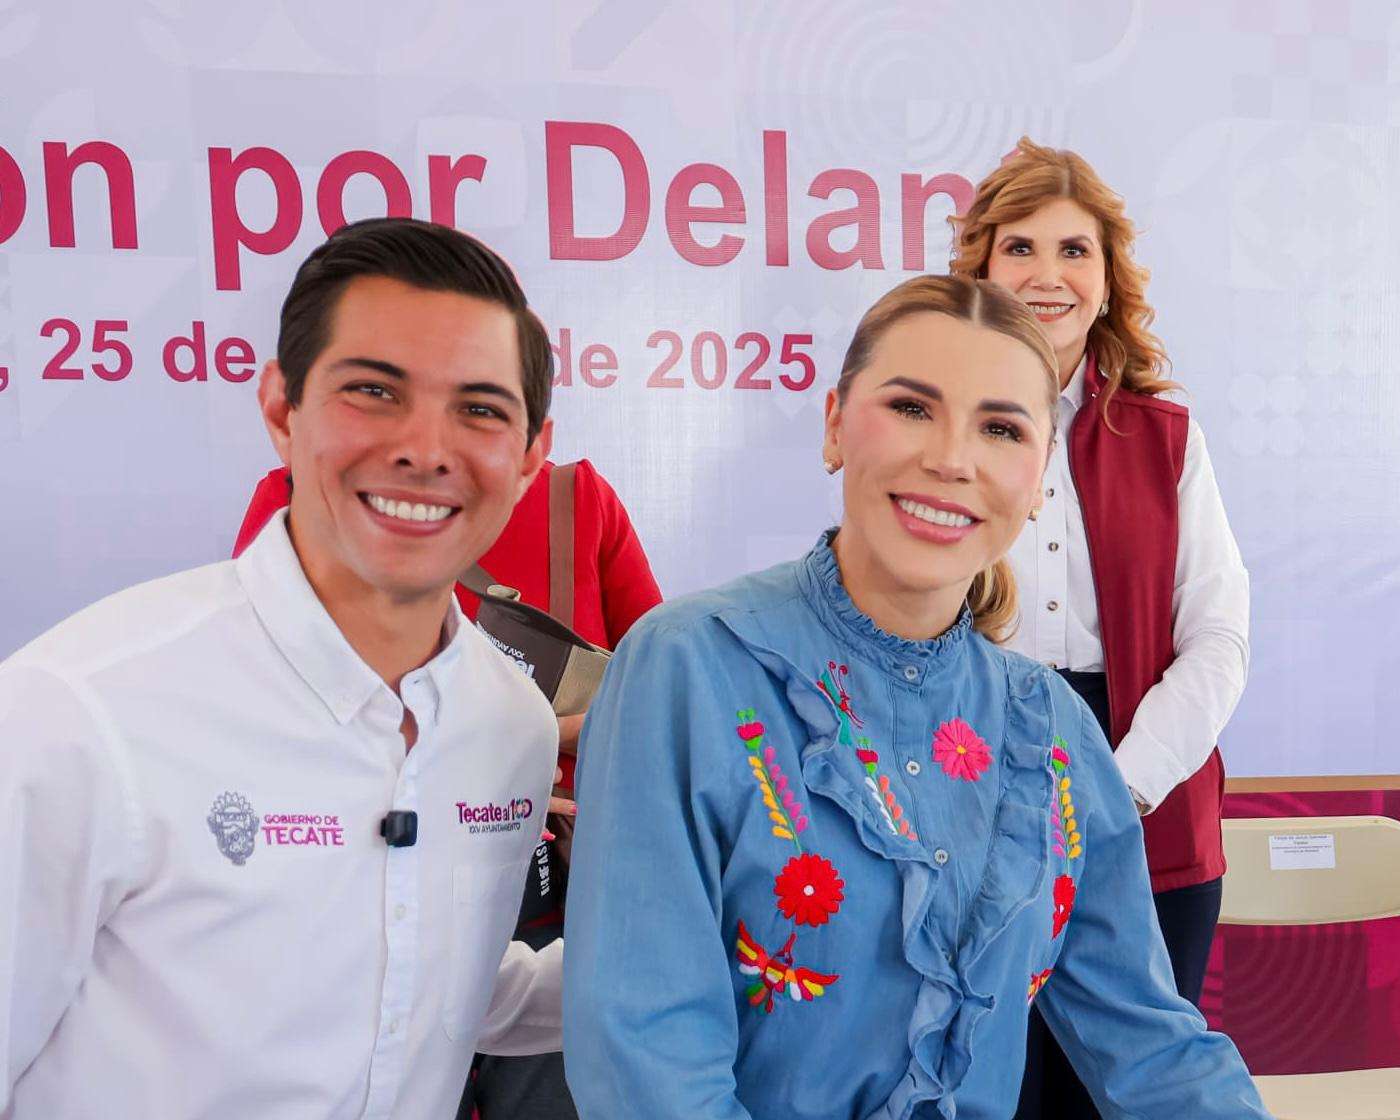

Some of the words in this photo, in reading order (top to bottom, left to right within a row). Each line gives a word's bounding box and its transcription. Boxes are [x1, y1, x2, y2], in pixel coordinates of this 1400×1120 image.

[0, 141, 138, 249] n
[208, 147, 487, 290] por
[544, 120, 1020, 272] Delan
[40, 318, 133, 382] 25
[163, 321, 256, 383] de
[550, 328, 618, 388] de
[646, 330, 816, 391] 2025
[261, 826, 344, 846] TECATE
[264, 814, 322, 825] GOBIERNO
[324, 815, 339, 825] DE
